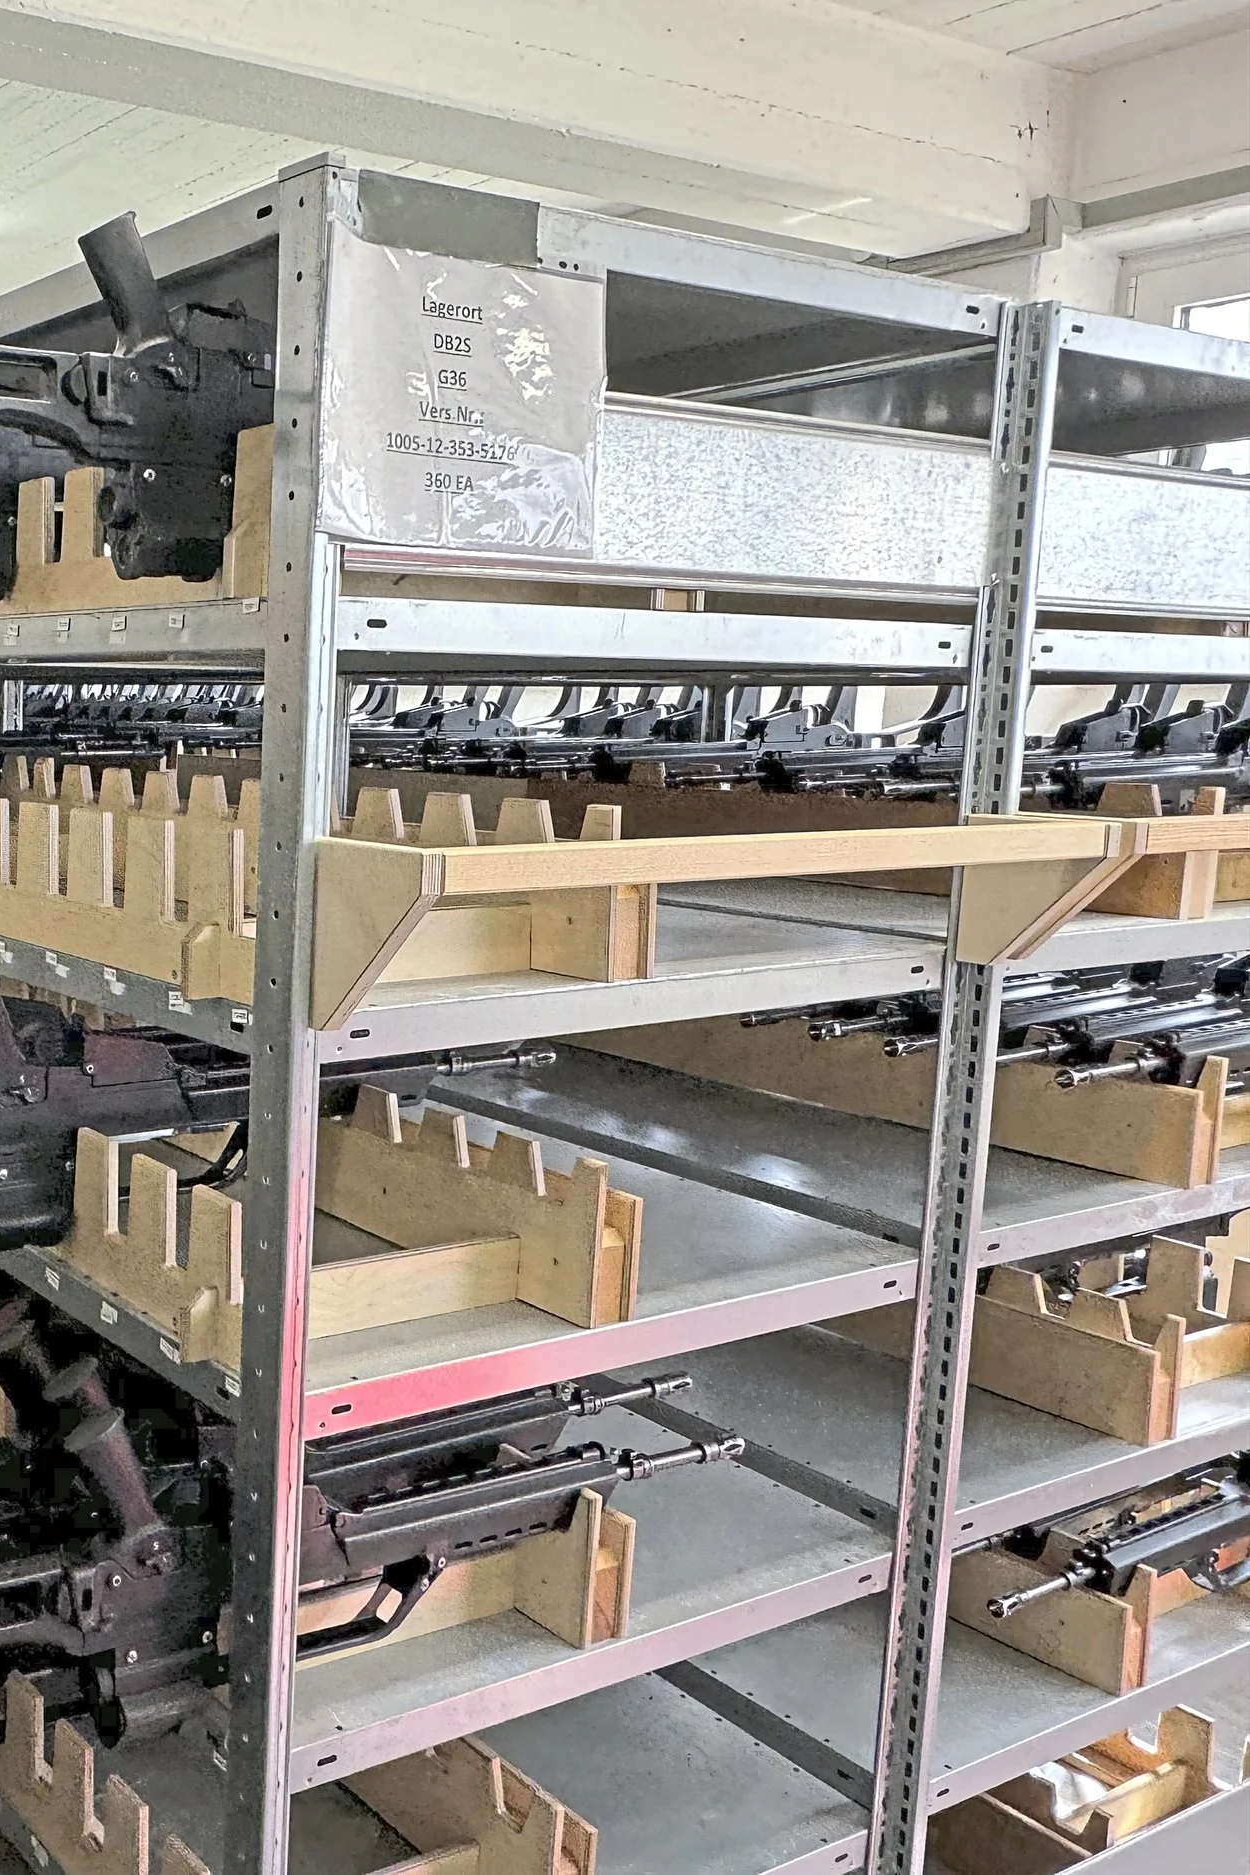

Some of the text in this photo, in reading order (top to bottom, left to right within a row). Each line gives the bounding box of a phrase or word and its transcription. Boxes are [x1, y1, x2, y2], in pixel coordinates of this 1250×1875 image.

[422, 295, 483, 321] Lagerort
[433, 333, 472, 353] DB2S
[438, 369, 467, 388] G36
[424, 471, 475, 491] 360 EA
